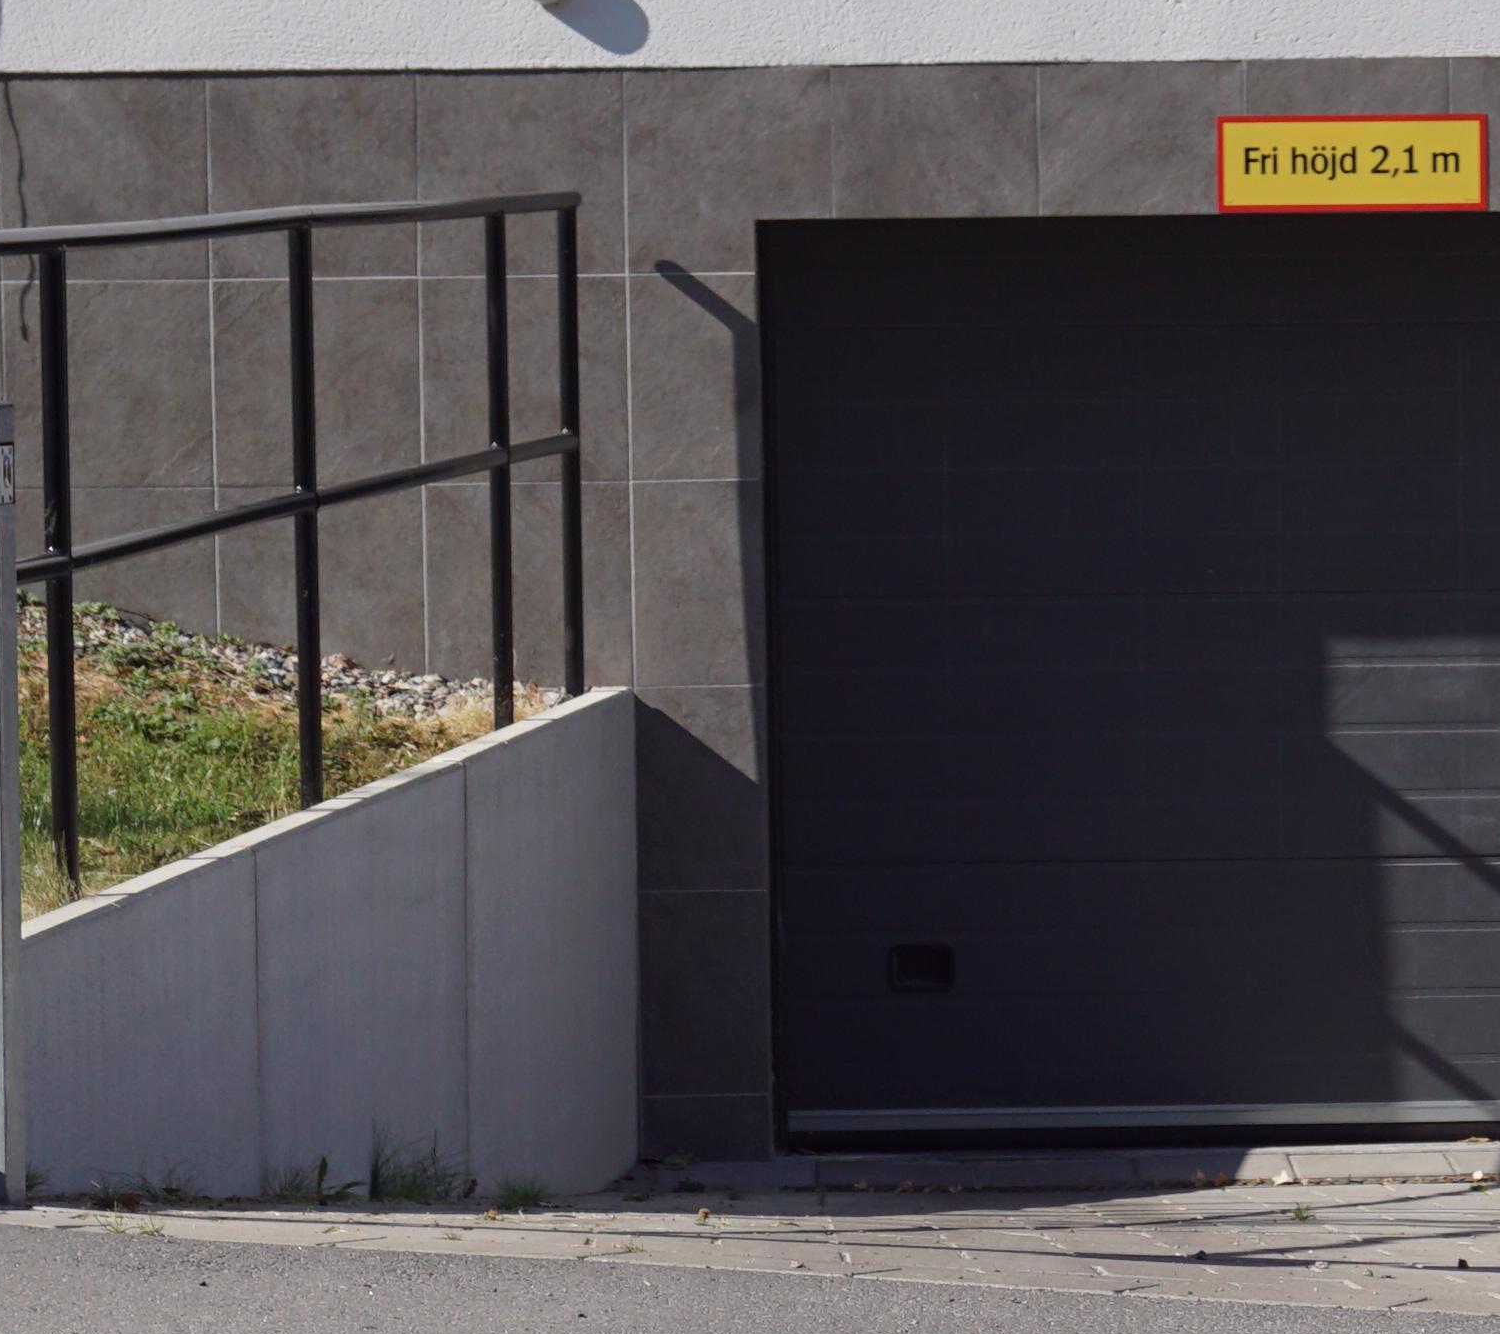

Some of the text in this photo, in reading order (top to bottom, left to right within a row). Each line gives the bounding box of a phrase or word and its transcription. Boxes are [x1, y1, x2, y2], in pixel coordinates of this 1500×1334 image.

[1243, 145, 1460, 180] Fri höjd 2,1 m
